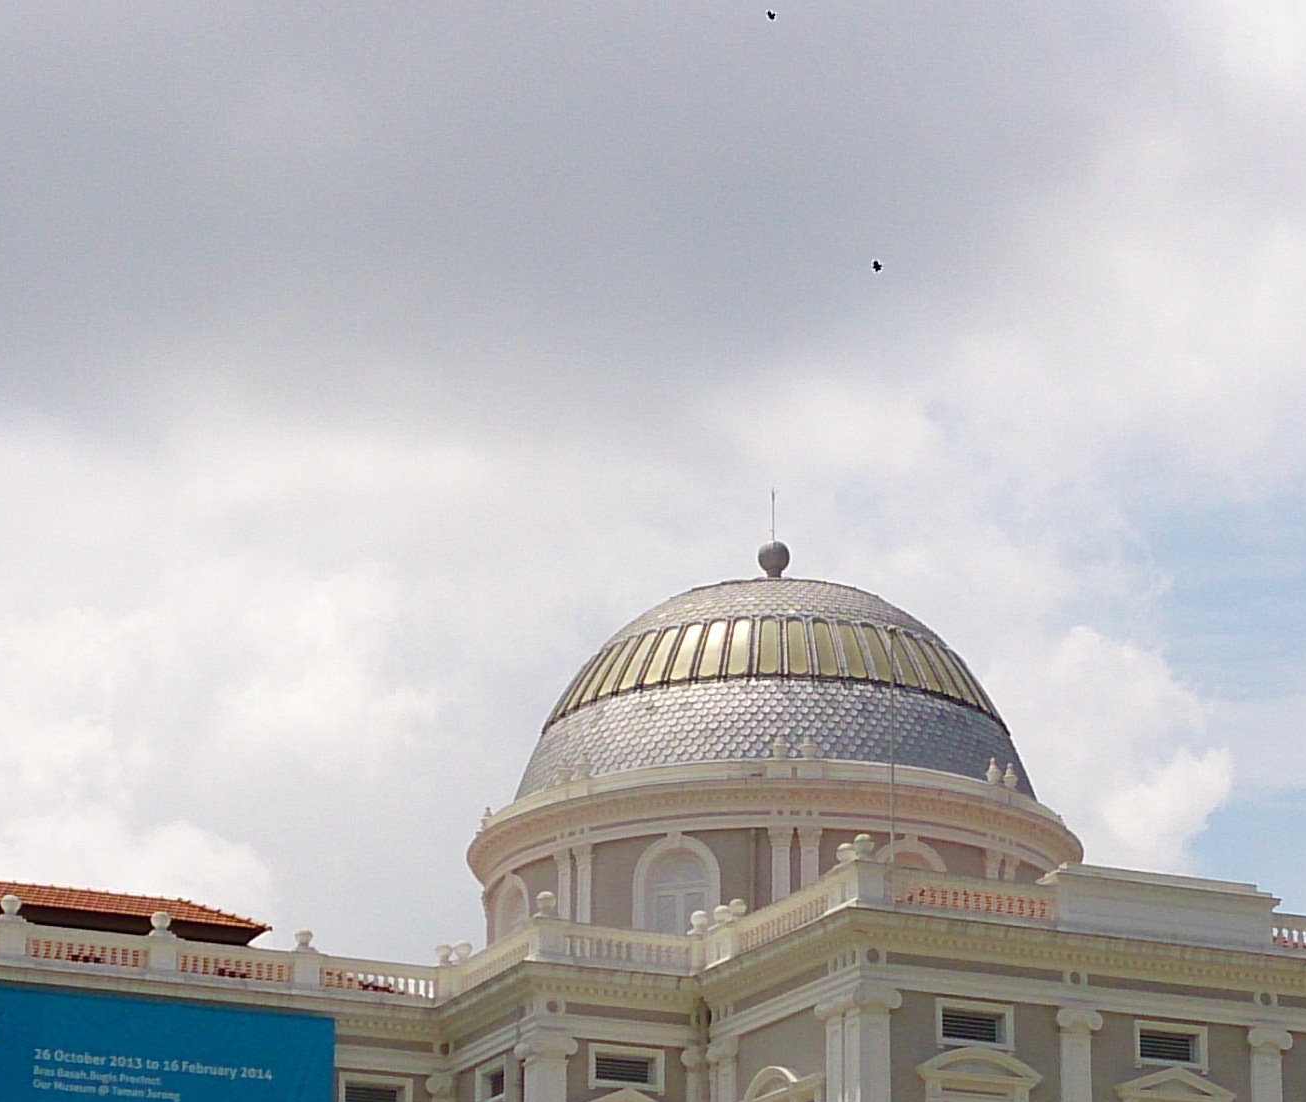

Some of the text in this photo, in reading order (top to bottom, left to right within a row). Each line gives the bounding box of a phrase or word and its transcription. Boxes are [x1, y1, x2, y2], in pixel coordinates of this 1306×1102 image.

[33, 1065, 55, 1077] Bras
[119, 1073, 162, 1087] Precinct
[34, 1048, 273, 1081] 26 October 2013 to 16 February 2014
[33, 1079, 181, 1102] Our Museum @ Taman Jurong
